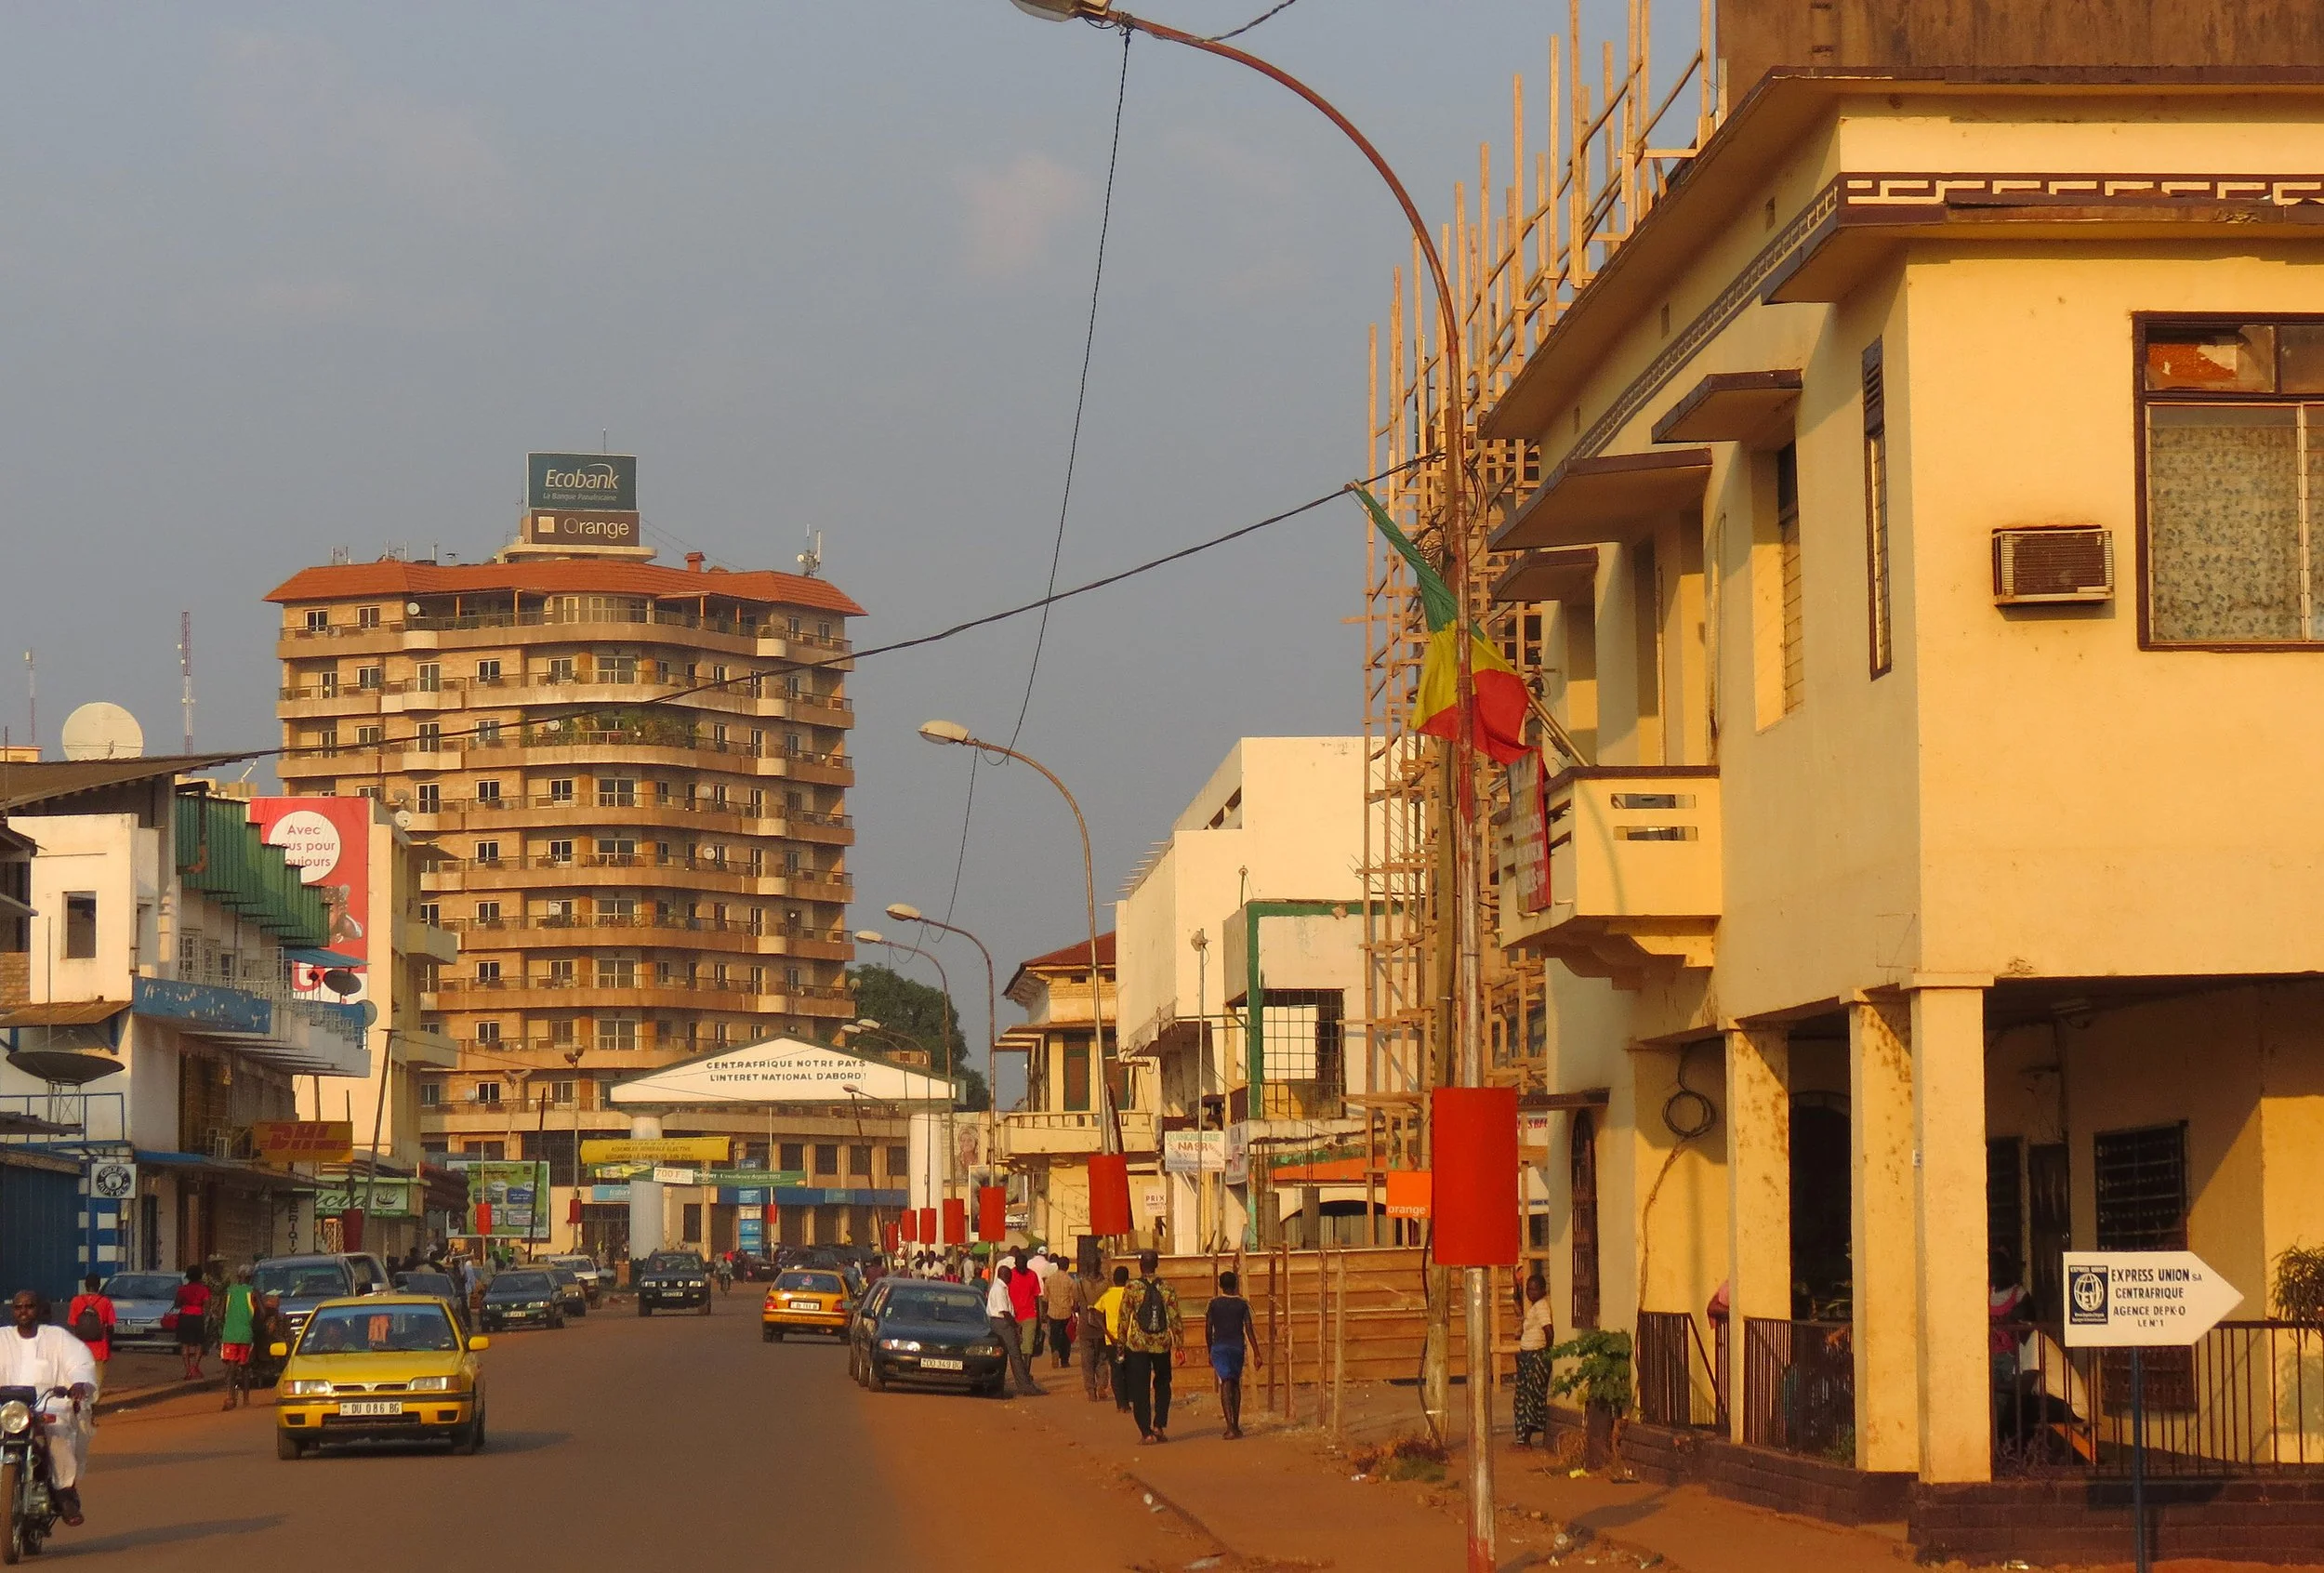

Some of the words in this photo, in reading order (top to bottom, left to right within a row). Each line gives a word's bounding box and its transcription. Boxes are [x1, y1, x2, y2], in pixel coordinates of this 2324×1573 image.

[546, 464, 620, 489] Ecobank
[563, 517, 629, 539] Orange
[287, 825, 321, 835] Avec
[306, 842, 336, 853] pour
[285, 856, 331, 866] oujours
[706, 1060, 793, 1069] CENTRAFRIQUE
[710, 1073, 759, 1082] L'INTERET
[762, 1073, 812, 1081] NATIONAL
[267, 1123, 337, 1150] DHL
[1388, 1205, 1426, 1216] orange
[2111, 1268, 2154, 1282] EXPRESS
[2159, 1268, 2189, 1282] UNION
[2115, 1288, 2184, 1300] CENTRAFRIQUE
[2113, 1306, 2149, 1315] AGENCE
[389, 1403, 400, 1413] BG
